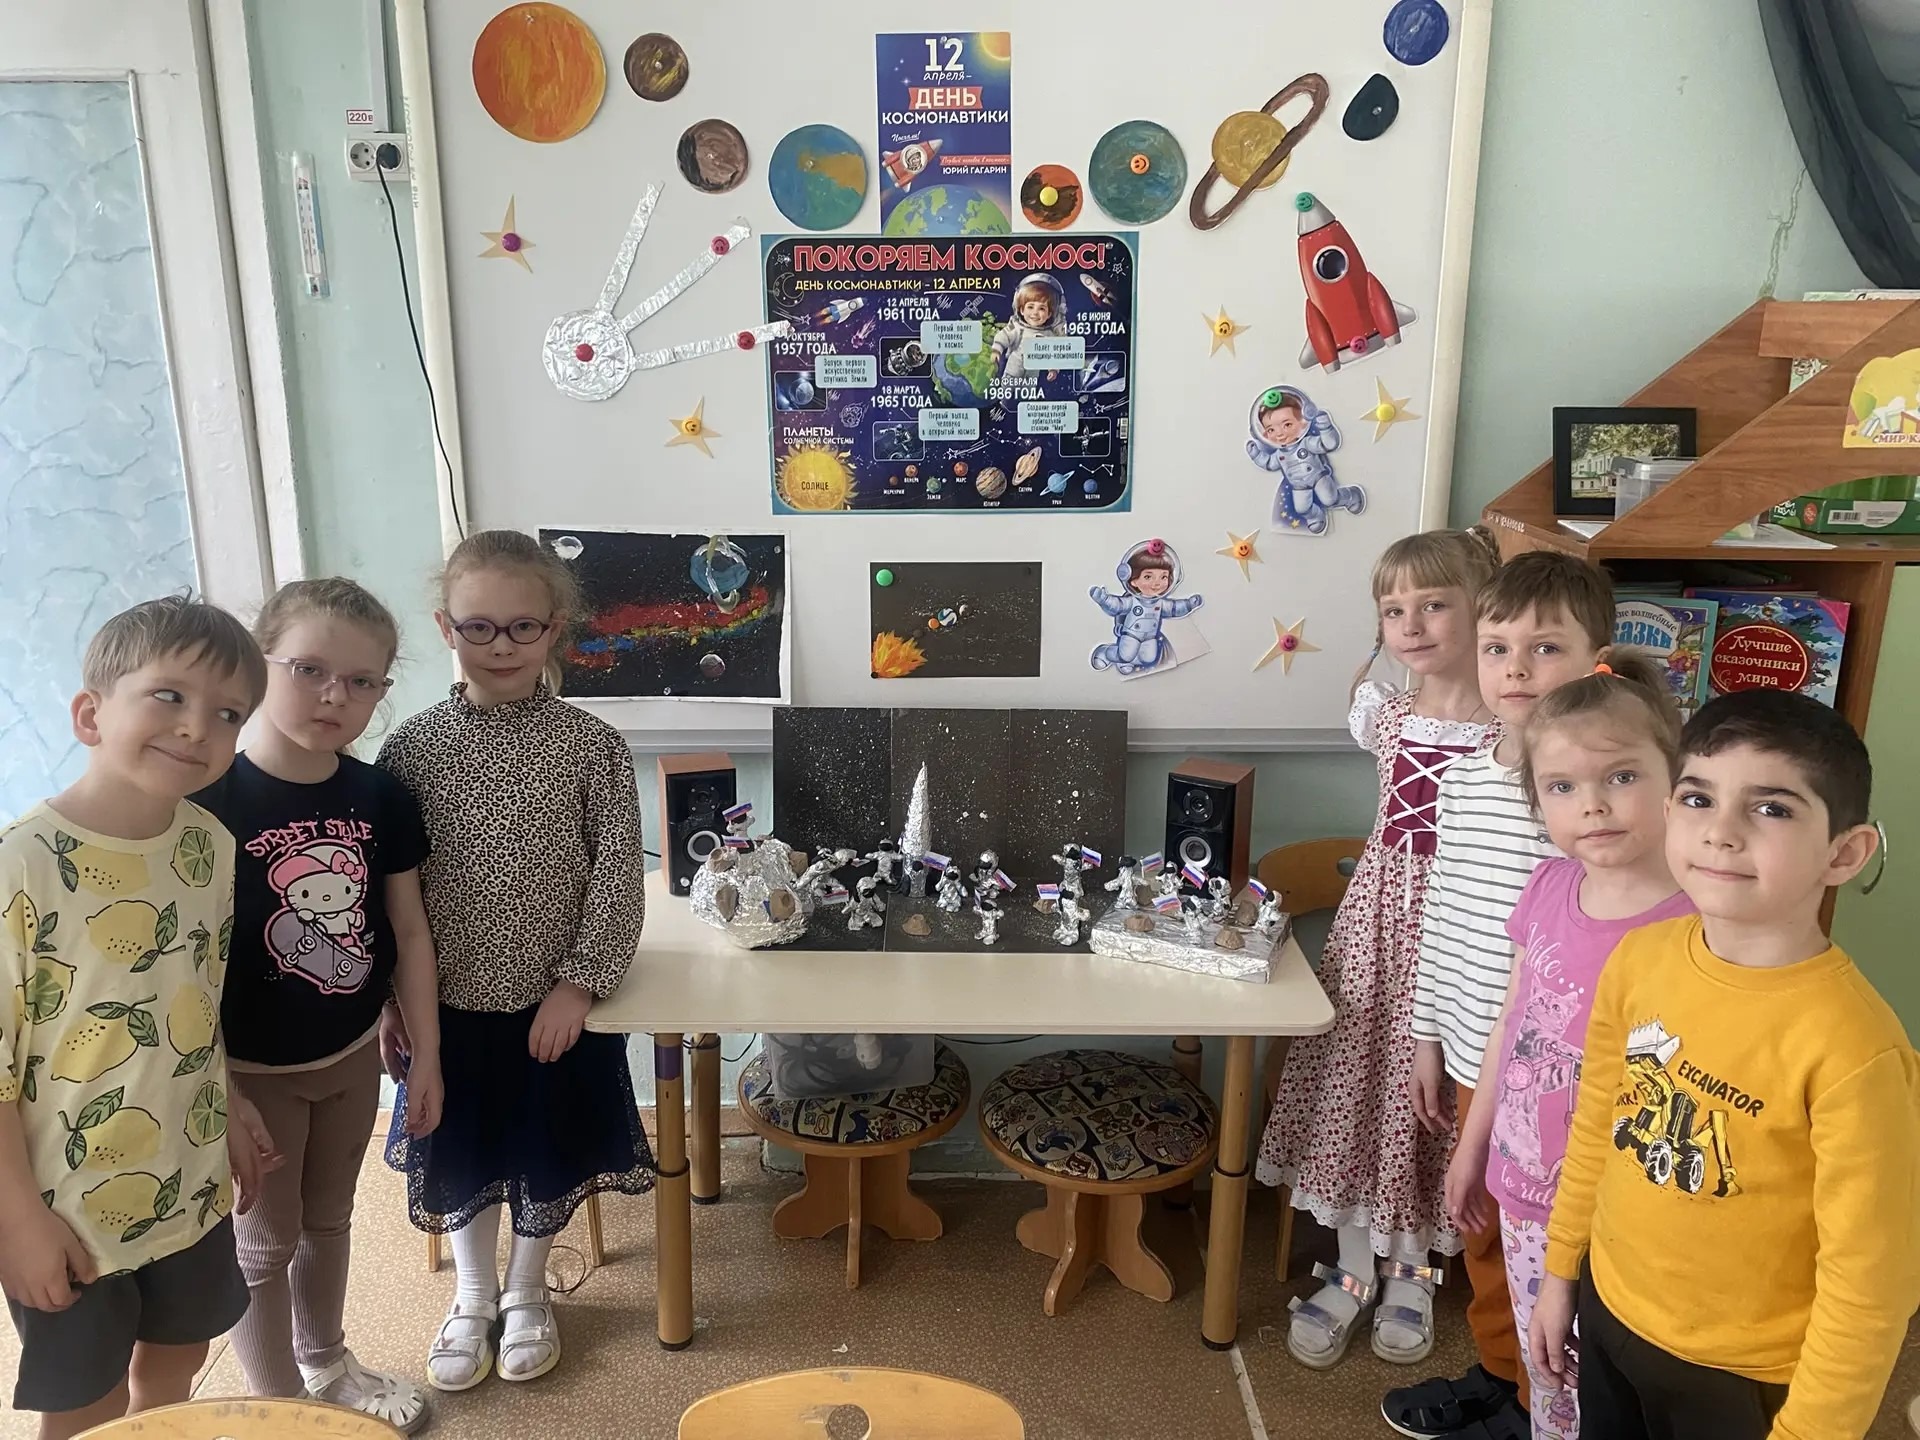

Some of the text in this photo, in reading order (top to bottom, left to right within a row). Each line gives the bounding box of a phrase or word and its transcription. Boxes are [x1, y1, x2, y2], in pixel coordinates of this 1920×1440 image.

[925, 38, 964, 72] 12
[915, 88, 977, 109] ДЕНЬ
[882, 111, 1009, 125] КОСМОНАВТИКИ
[943, 166, 1007, 175] ЮРИЙ ГАГАРИН
[793, 243, 1106, 272] ПОКОРЯЕМ КОСМОС!
[795, 280, 824, 291] ДЕНЬ
[826, 279, 922, 290] КОСМОНАВТИКИ
[933, 279, 945, 290] 12
[949, 277, 1001, 289] АПРЕЛЯ
[887, 298, 930, 307] 12 АПРЕЛЯ
[877, 308, 940, 321] 1961 ГОДА
[1077, 312, 1111, 321] 16 ИЮНЯ
[1063, 322, 1126, 335] 1963 ГОДА
[791, 332, 826, 341] ОКТЯБРЯ
[775, 342, 837, 355] 1957 ГОДА
[989, 377, 1038, 387] 20 ФЕВРАЛЯ
[882, 385, 921, 395] 18 МАРТА
[983, 387, 1045, 400] 1986 ГОДА
[871, 396, 933, 408] 1965 ГОДА
[783, 427, 834, 437] ПЛАНЕТЫ
[783, 436, 855, 445] СОЛНЕЧНОЙ СИСТЕМЫ
[801, 481, 829, 491] СОЛНЦЕ
[1631, 609, 1677, 633] волшебные
[1729, 635, 1792, 654] Лучшие
[1714, 653, 1801, 672] сказочники
[245, 821, 318, 857] STREET
[1677, 1060, 1765, 1118] EXCAVATOR
[1520, 1182, 1554, 1206] rid
